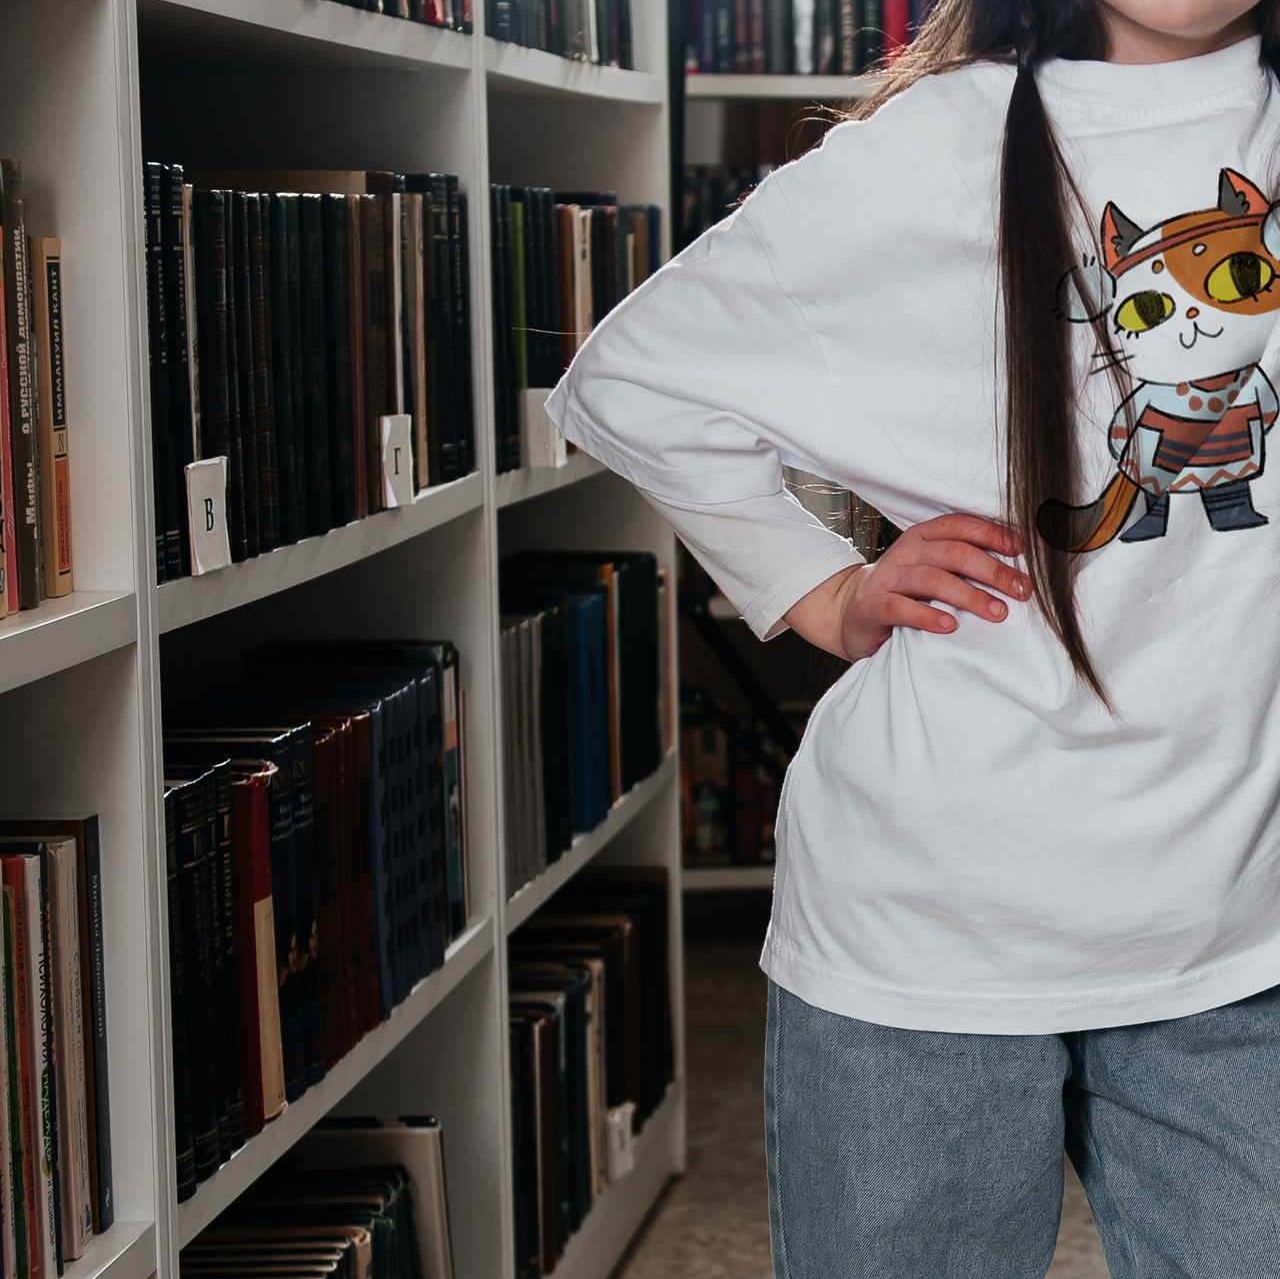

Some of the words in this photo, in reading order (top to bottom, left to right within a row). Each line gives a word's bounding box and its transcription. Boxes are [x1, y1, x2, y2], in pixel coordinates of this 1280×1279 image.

[16, 343, 29, 418] РУССКОЙ
[54, 319, 63, 421] ИММАНУИЛ
[26, 462, 36, 525] Мифы
[394, 446, 401, 475] Г
[205, 498, 214, 532] В
[95, 942, 104, 1038] Лабковский
